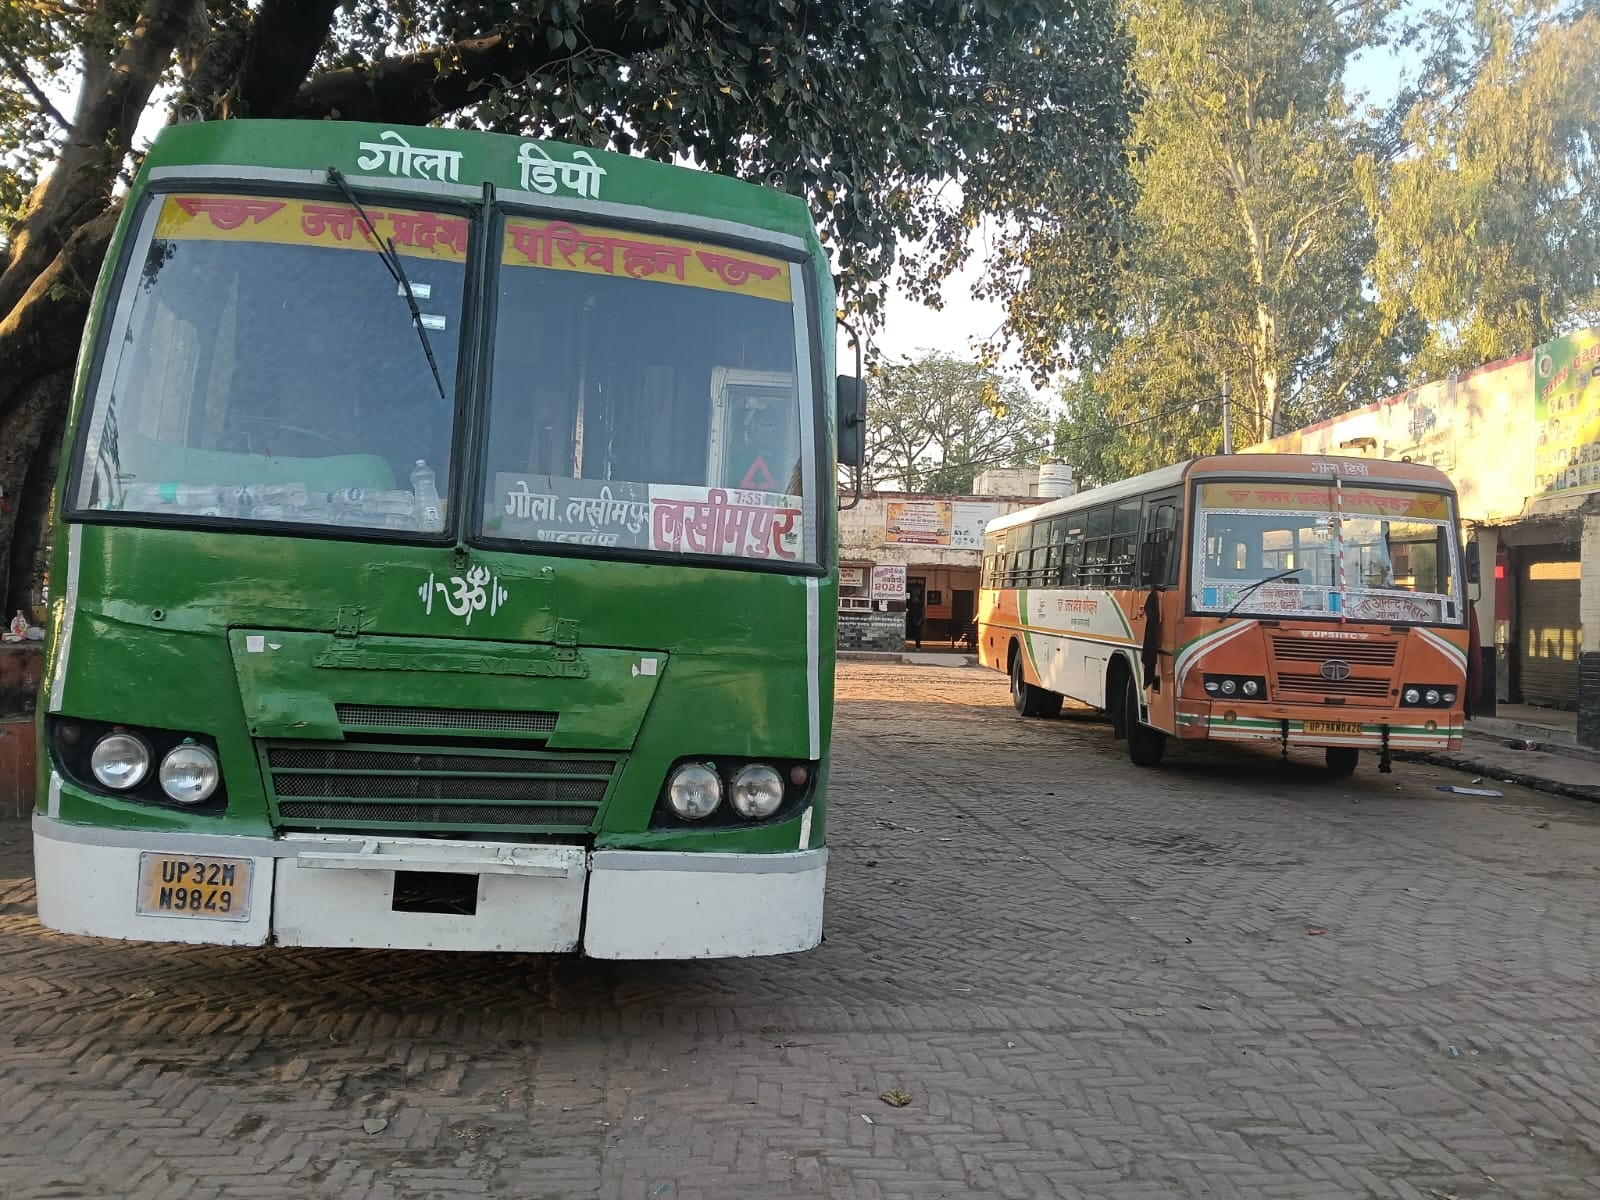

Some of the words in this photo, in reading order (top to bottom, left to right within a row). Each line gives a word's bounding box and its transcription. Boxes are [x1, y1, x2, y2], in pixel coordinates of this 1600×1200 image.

[357, 130, 464, 184] गोला
[517, 142, 607, 199] डिपो
[301, 205, 385, 246] उत्तर
[388, 211, 469, 254] प्रदेश
[507, 221, 691, 281] परिवहन
[1311, 459, 1340, 475] गोला
[734, 491, 762, 505] 7:55
[1255, 491, 1291, 504] उत्तर
[1343, 491, 1417, 511] परिवहन
[651, 489, 801, 558] लखीमपुर
[874, 583, 904, 592] 2025
[162, 860, 236, 886] UP32M
[159, 886, 232, 912] N9849
